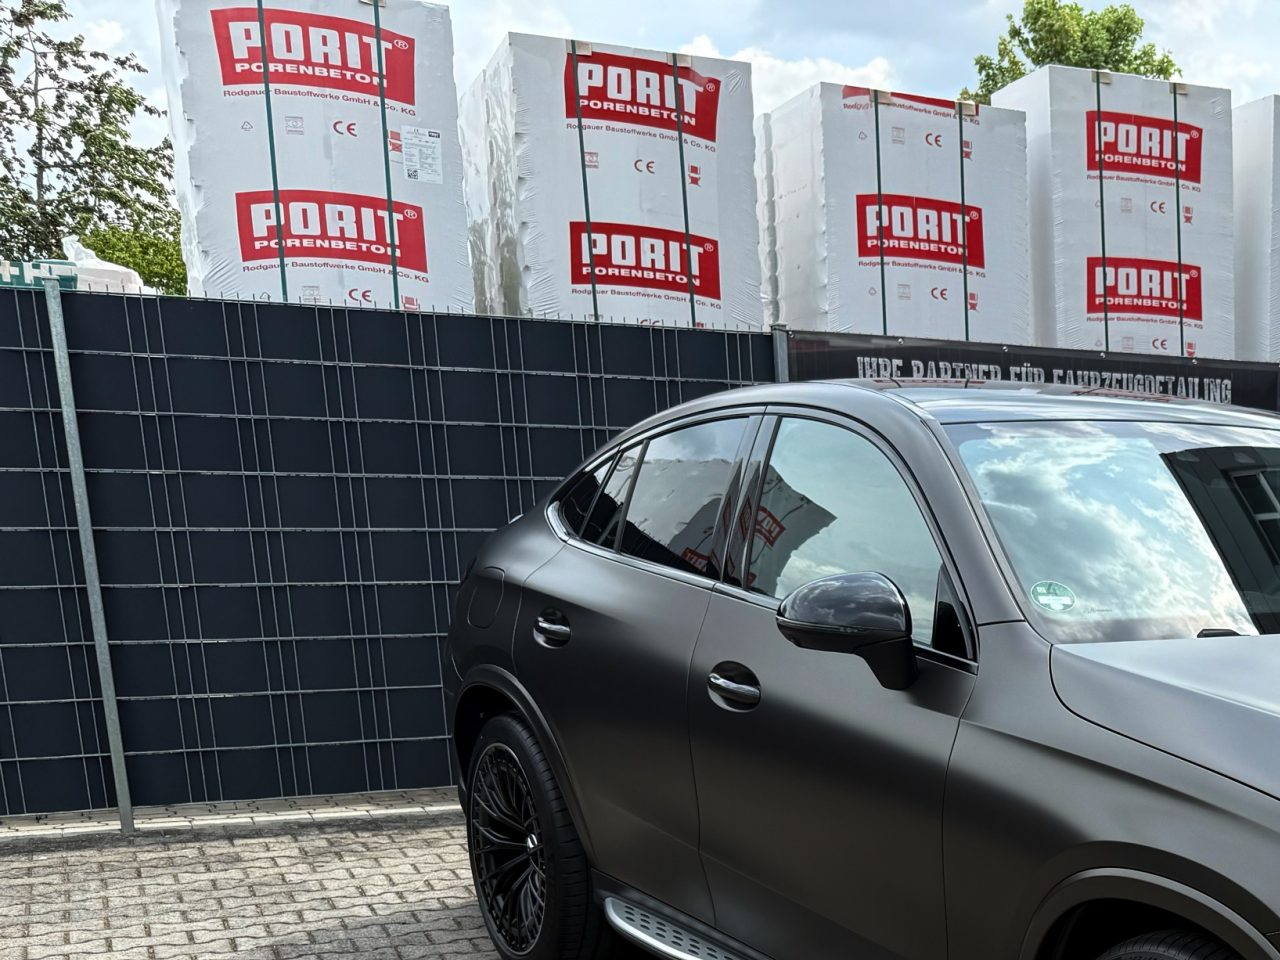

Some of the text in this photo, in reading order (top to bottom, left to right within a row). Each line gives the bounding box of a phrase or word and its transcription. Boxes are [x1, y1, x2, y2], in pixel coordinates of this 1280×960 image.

[235, 62, 387, 88] PORENBETON
[274, 88, 340, 101] Baustoffwerke
[342, 94, 371, 106] GmbH
[400, 106, 416, 116] KG
[579, 99, 696, 126] PORENBETON
[333, 120, 358, 137] CE
[605, 124, 657, 138] Baustoffwerke
[690, 140, 703, 148] Co.
[704, 144, 716, 153] KG
[925, 132, 942, 148] CE
[634, 159, 656, 174] CE
[1095, 154, 1187, 172] PORENBETON
[1150, 201, 1166, 214] CE
[254, 238, 401, 257] PORENBETON
[867, 239, 968, 256] PORENBETON
[291, 261, 356, 271] Baustoffwerke
[358, 265, 386, 275] GmbH
[397, 271, 412, 280] Co.
[414, 274, 429, 284] KG
[582, 267, 700, 287] PORENBETON
[348, 288, 372, 303] CE
[610, 289, 662, 300] Baustoffwerke
[664, 294, 687, 303] GmbH
[710, 301, 722, 310] KG
[931, 287, 948, 301] CE
[1095, 297, 1187, 311] PORENBETON
[1152, 338, 1168, 350] CE
[856, 356, 1232, 404] IHRE PARTNER FÜR FAHRZEUGDETAILING
